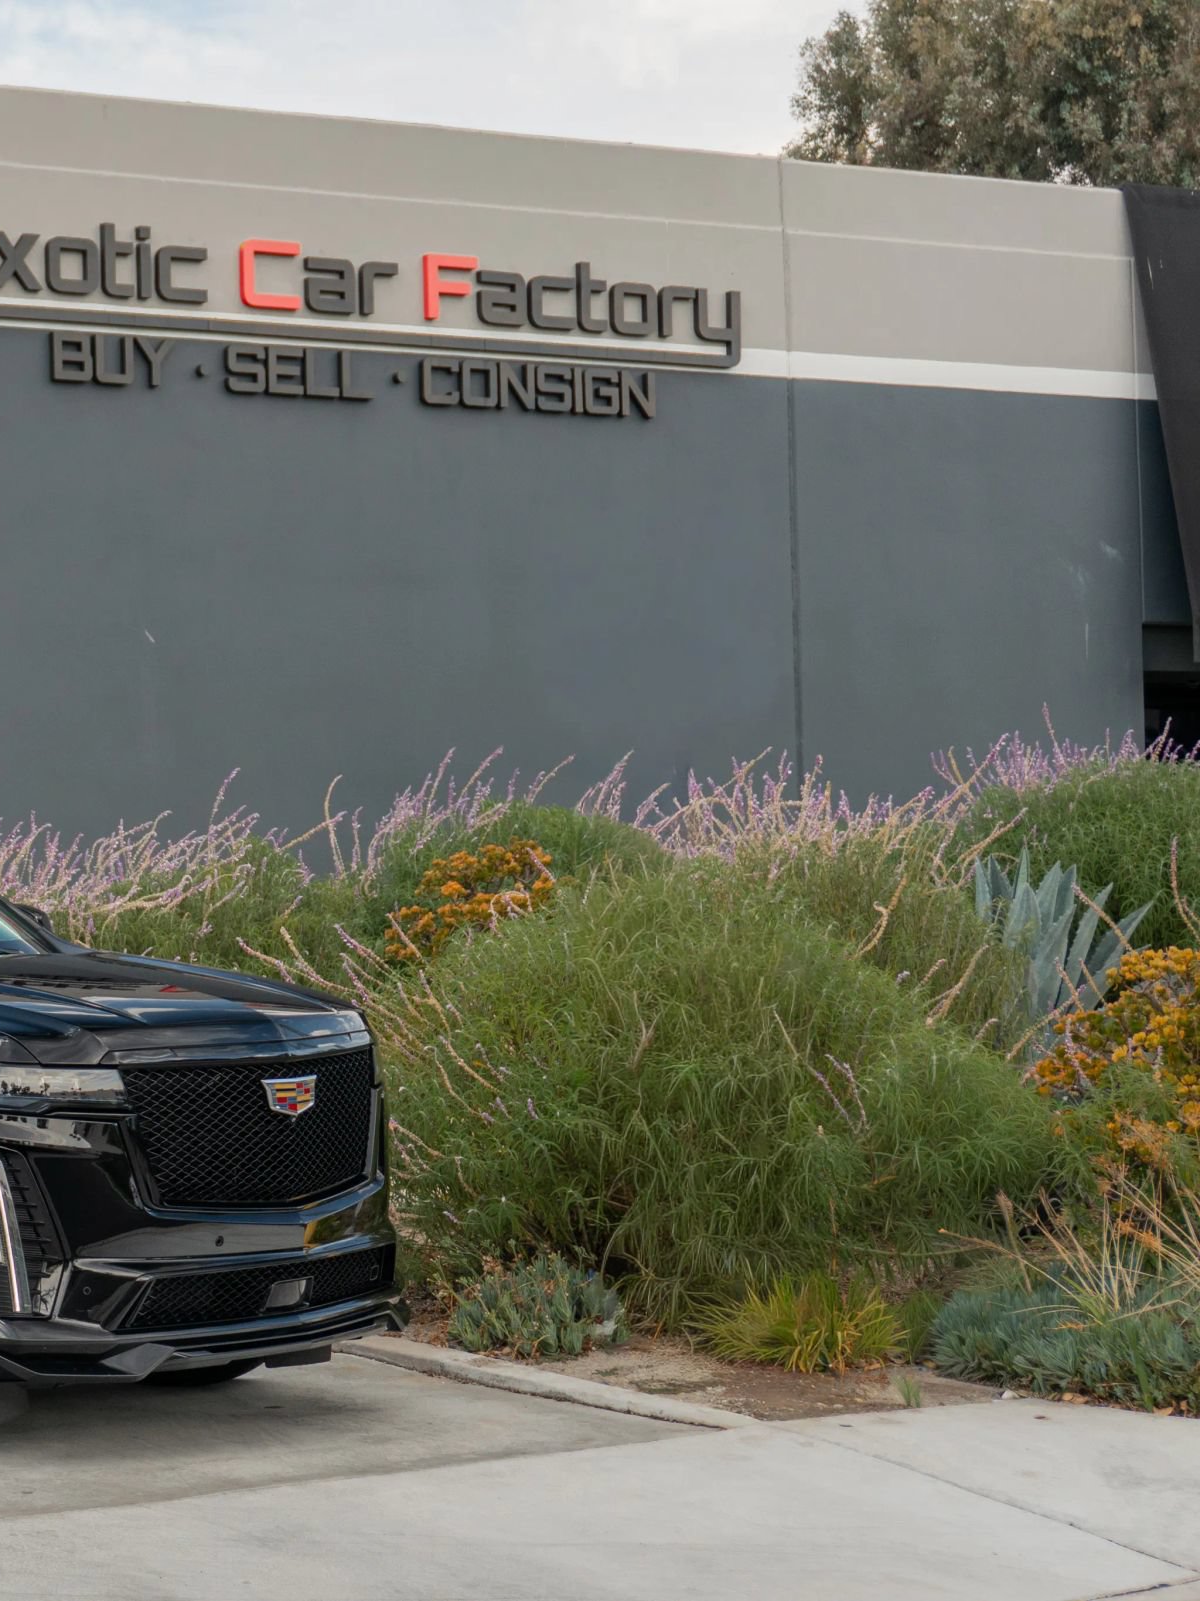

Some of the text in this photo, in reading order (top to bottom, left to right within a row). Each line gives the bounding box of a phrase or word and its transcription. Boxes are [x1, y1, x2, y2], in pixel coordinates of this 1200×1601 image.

[239, 239, 399, 317] Car
[422, 253, 741, 368] Factory
[49, 331, 657, 419] BUY SELL CONSIGN
